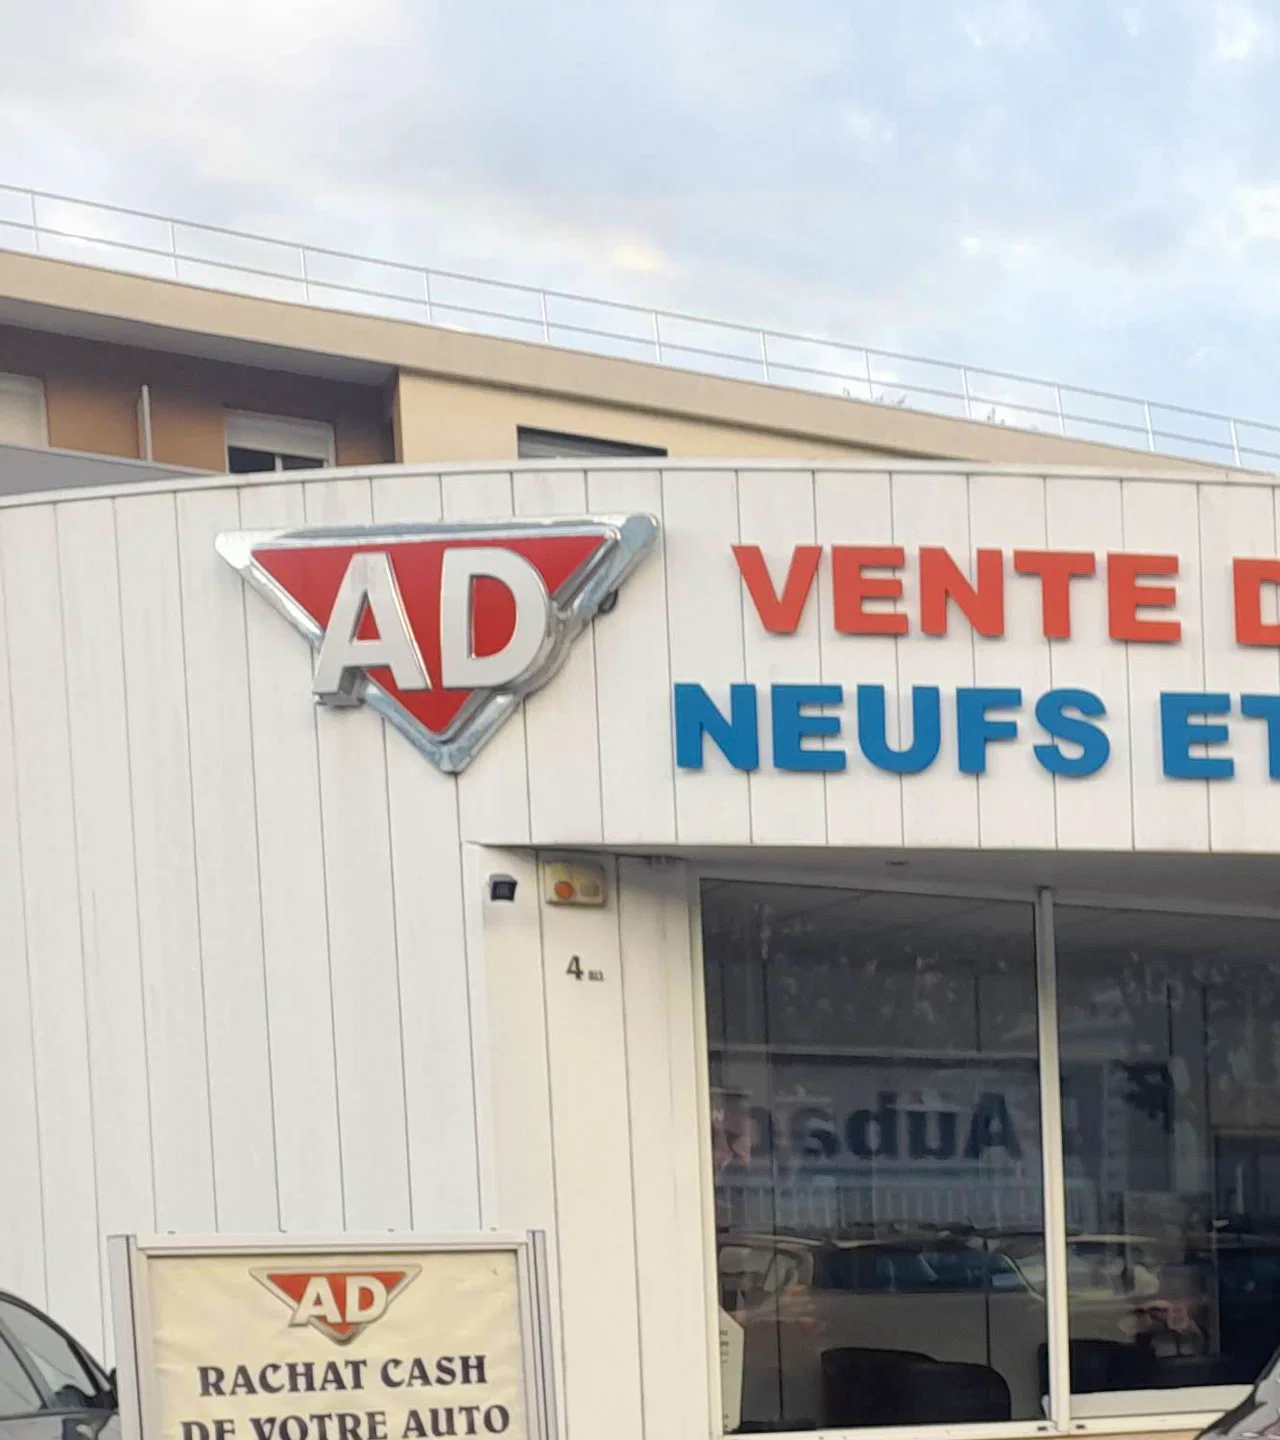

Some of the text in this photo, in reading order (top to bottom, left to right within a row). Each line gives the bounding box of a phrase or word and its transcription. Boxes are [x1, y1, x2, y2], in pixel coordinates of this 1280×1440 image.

[731, 545, 1182, 642] VENTE
[312, 547, 552, 695] AD
[674, 682, 1111, 778] NEUFS
[565, 954, 585, 981] 4
[289, 1275, 388, 1326] AD
[197, 1355, 488, 1397] RACHAT CASH
[401, 1403, 511, 1440] AUTO
